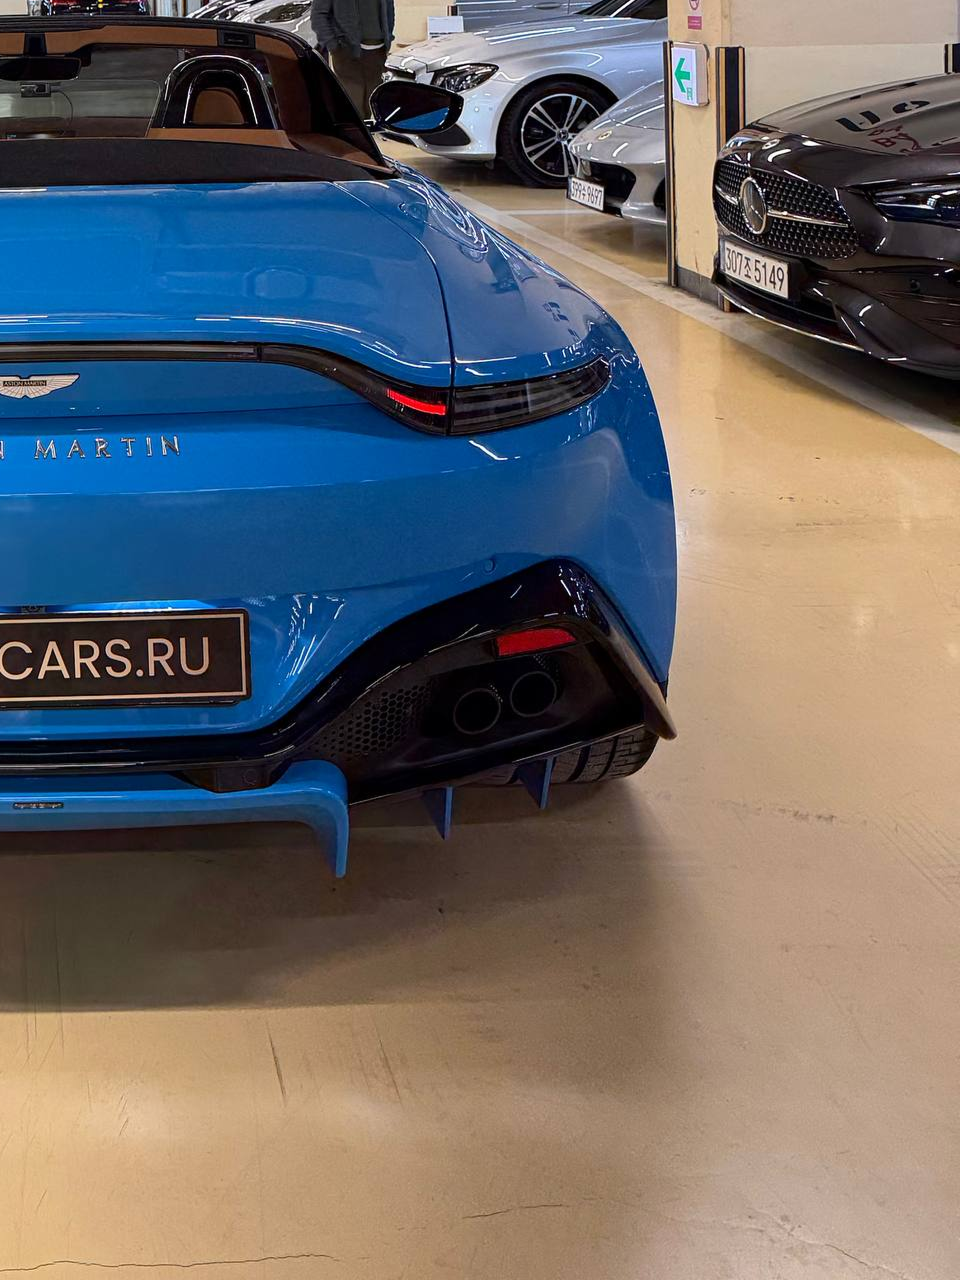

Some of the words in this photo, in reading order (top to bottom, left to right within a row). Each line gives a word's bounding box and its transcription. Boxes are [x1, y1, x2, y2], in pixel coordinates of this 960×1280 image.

[725, 247, 752, 279] 307조
[754, 259, 785, 292] 5149
[33, 435, 181, 460] MARTIN
